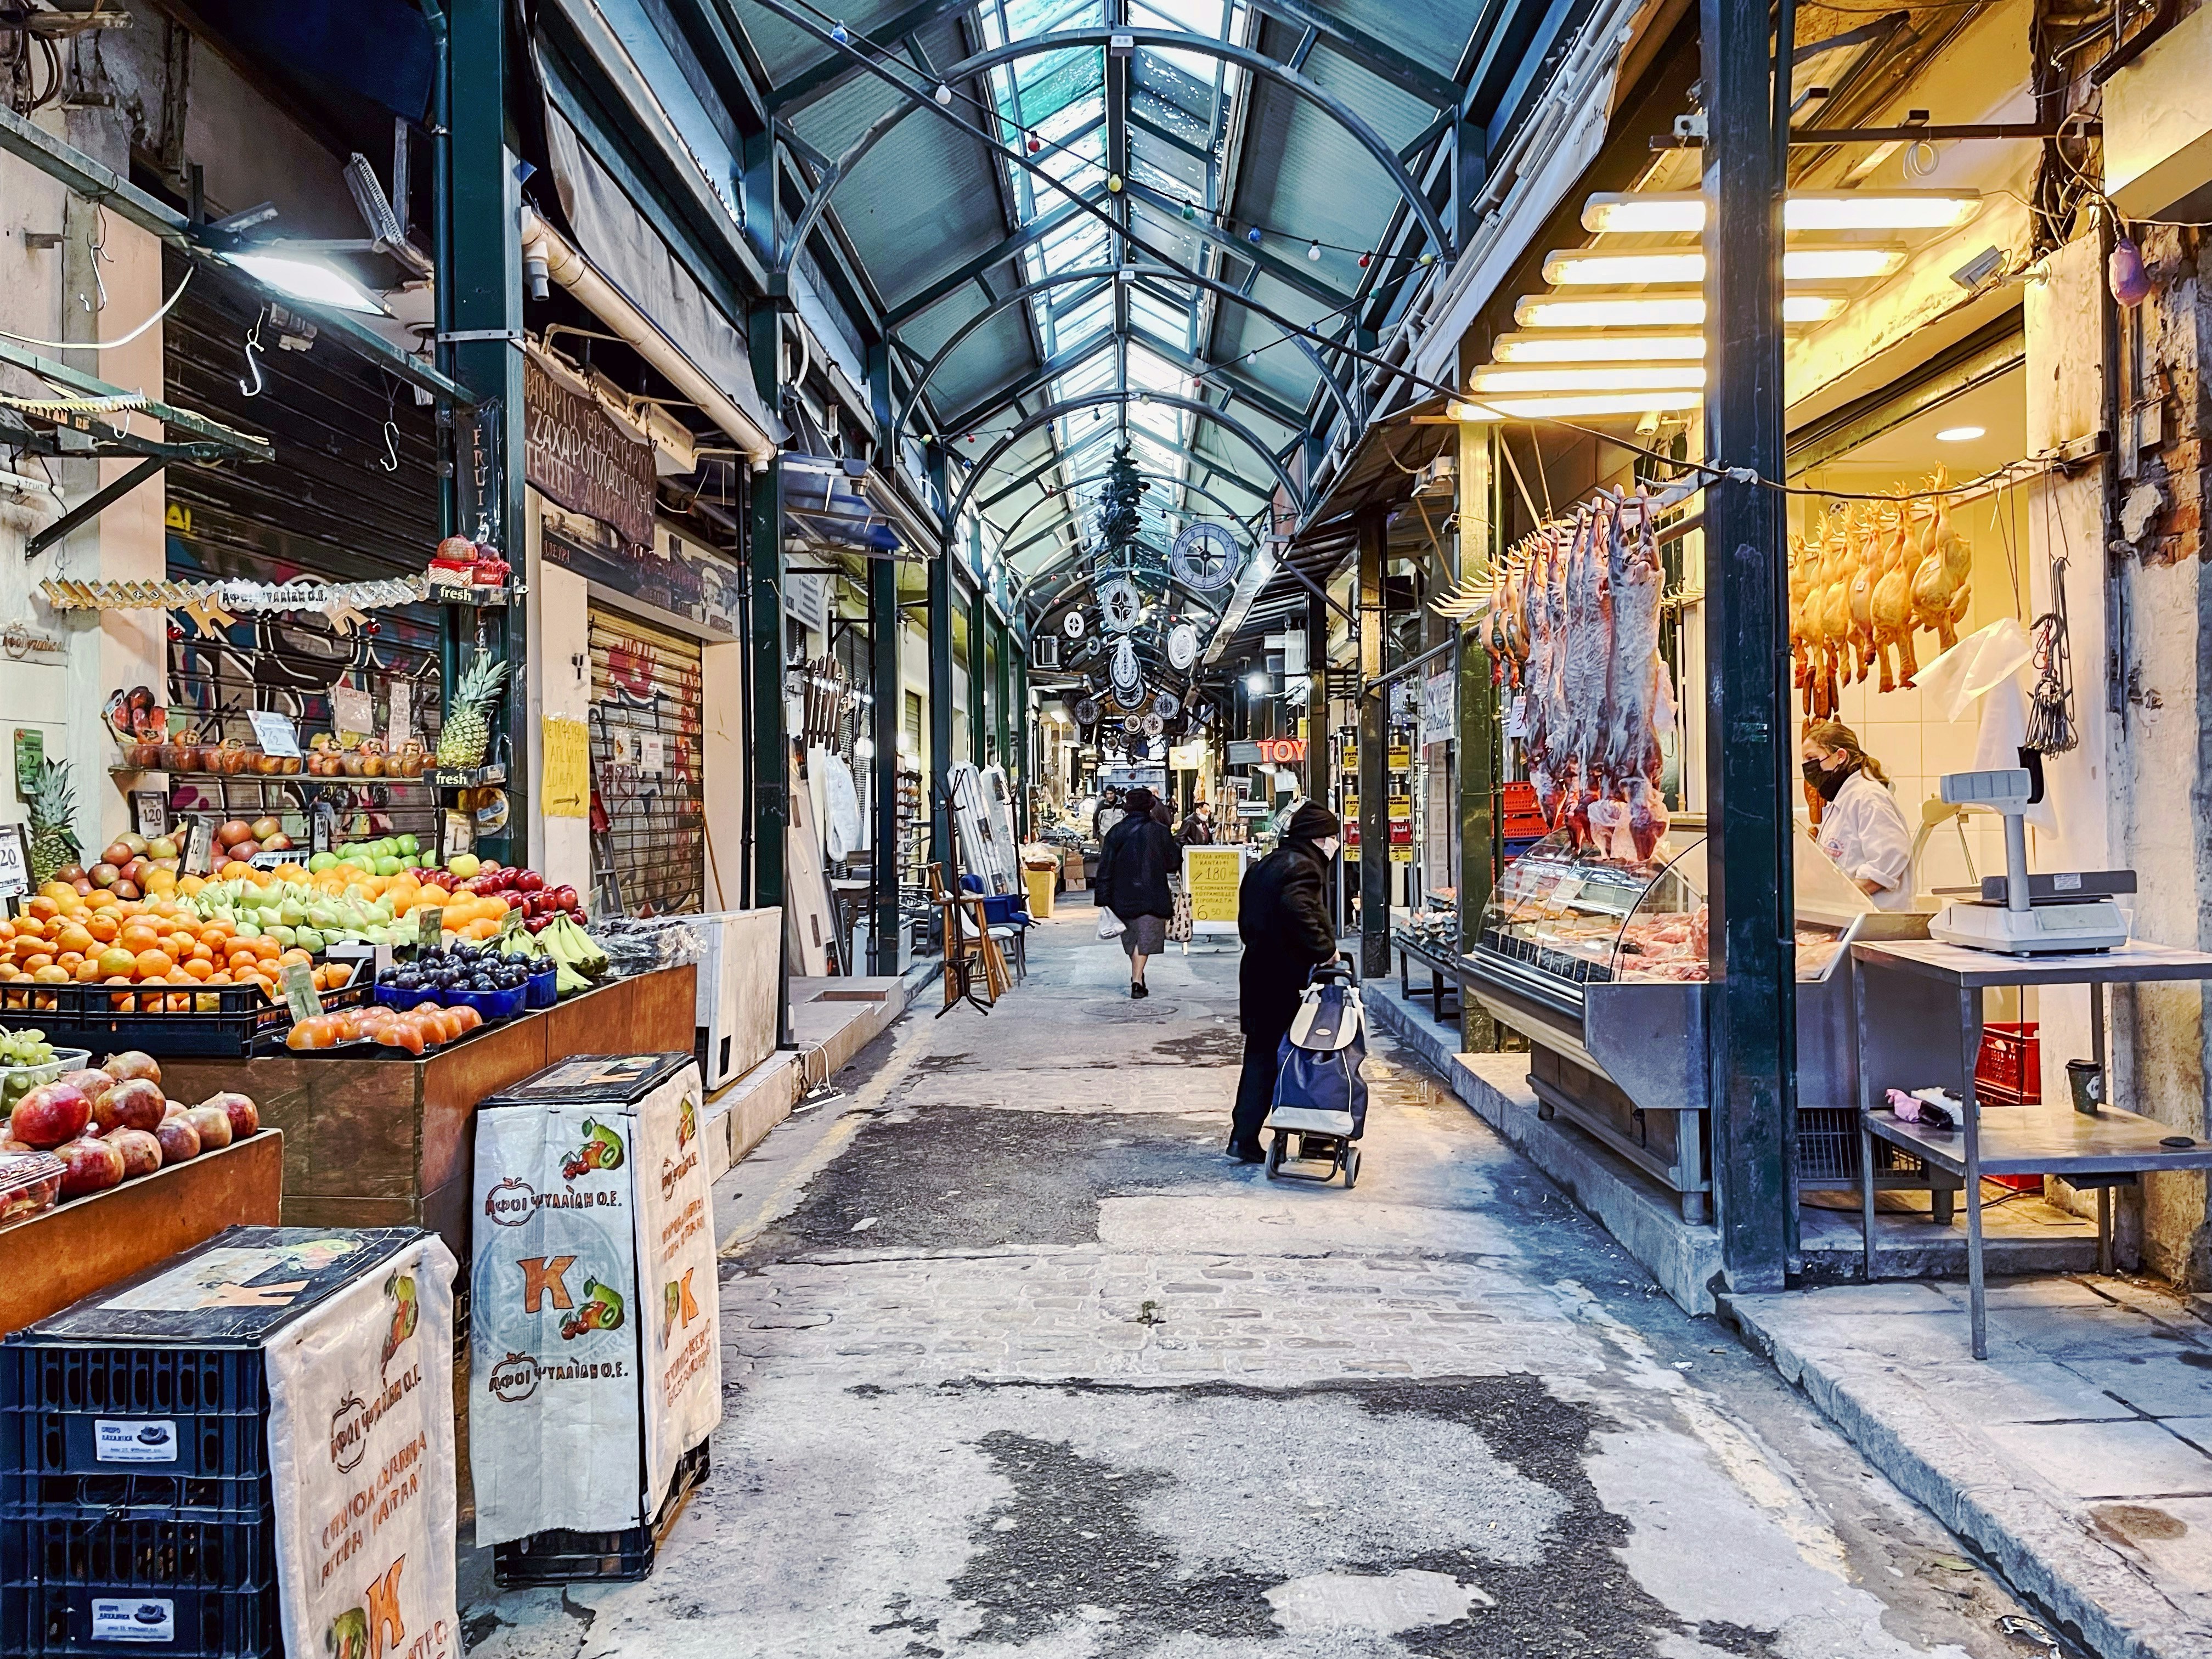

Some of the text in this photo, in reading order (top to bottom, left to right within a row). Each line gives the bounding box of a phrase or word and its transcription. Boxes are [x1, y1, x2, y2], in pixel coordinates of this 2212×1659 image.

[25, 478, 44, 492] fruit
[473, 428, 486, 527] FRUIT
[439, 585, 472, 602] fresh
[1256, 740, 1307, 763] TOY
[435, 770, 467, 785] fresh
[143, 809, 162, 823] 120
[1197, 905, 1208, 920] 6
[596, 1190, 622, 1207] Ο.Ε.
[489, 1370, 531, 1392] ΑΦΟΙ
[601, 1361, 629, 1378] Ο.Ε.
